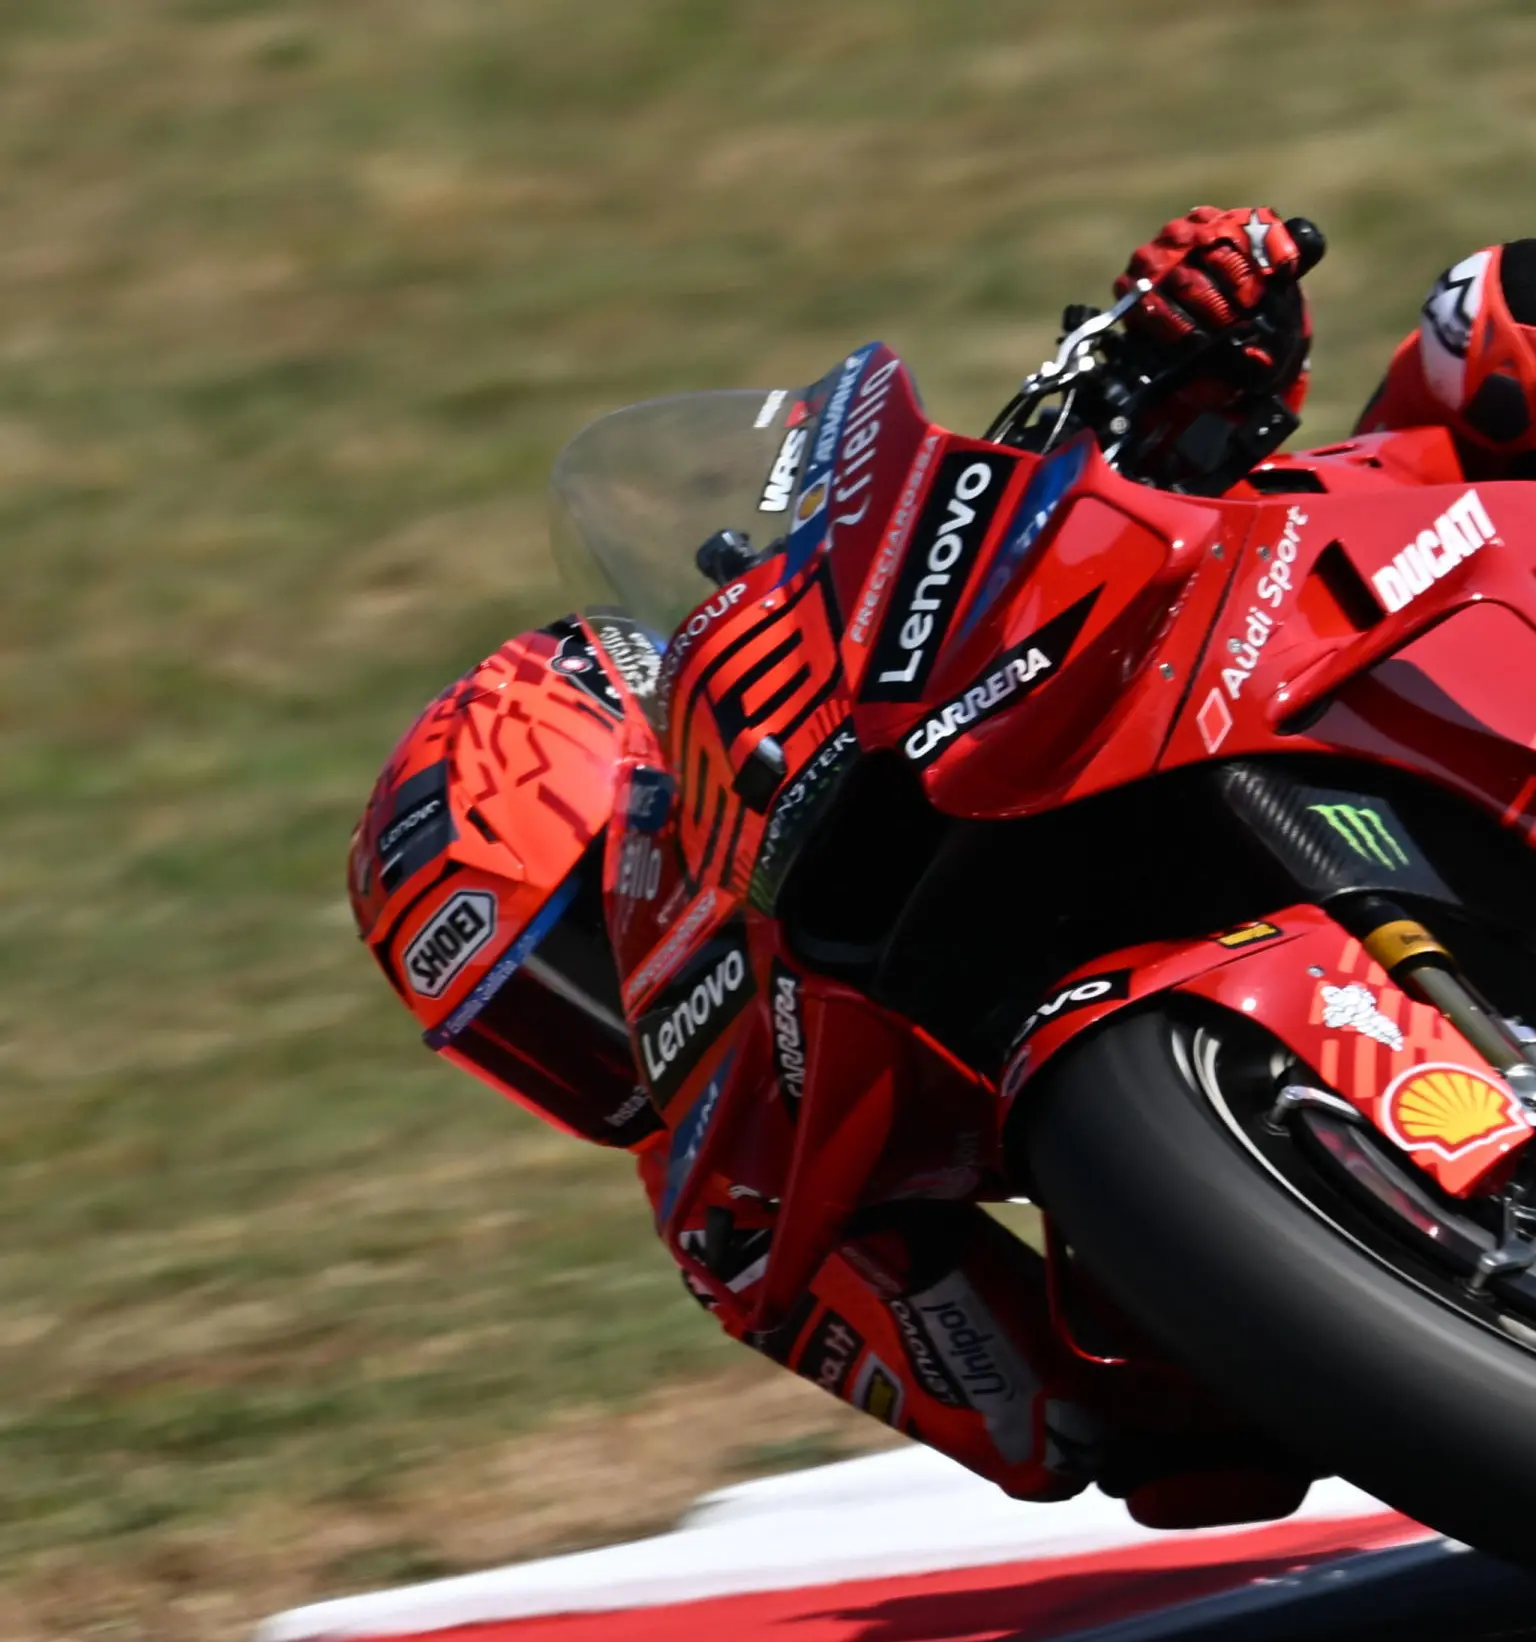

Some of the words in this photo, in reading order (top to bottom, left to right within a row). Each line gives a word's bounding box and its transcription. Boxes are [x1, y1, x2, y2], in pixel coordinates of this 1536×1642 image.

[758, 425, 809, 513] WRS
[849, 434, 942, 645] FRECCIAROSSA
[877, 461, 993, 684] Lenovo
[1371, 488, 1497, 614] DUCATI
[664, 581, 748, 678] GROUP
[1219, 604, 1274, 700] Audi
[1256, 504, 1310, 608] Sport
[903, 647, 1052, 760] CARRERA
[408, 899, 488, 991] SHOEI
[640, 948, 745, 1083] Lenovo
[772, 975, 807, 1099] CARRERA
[919, 1299, 1006, 1397] Unipol
